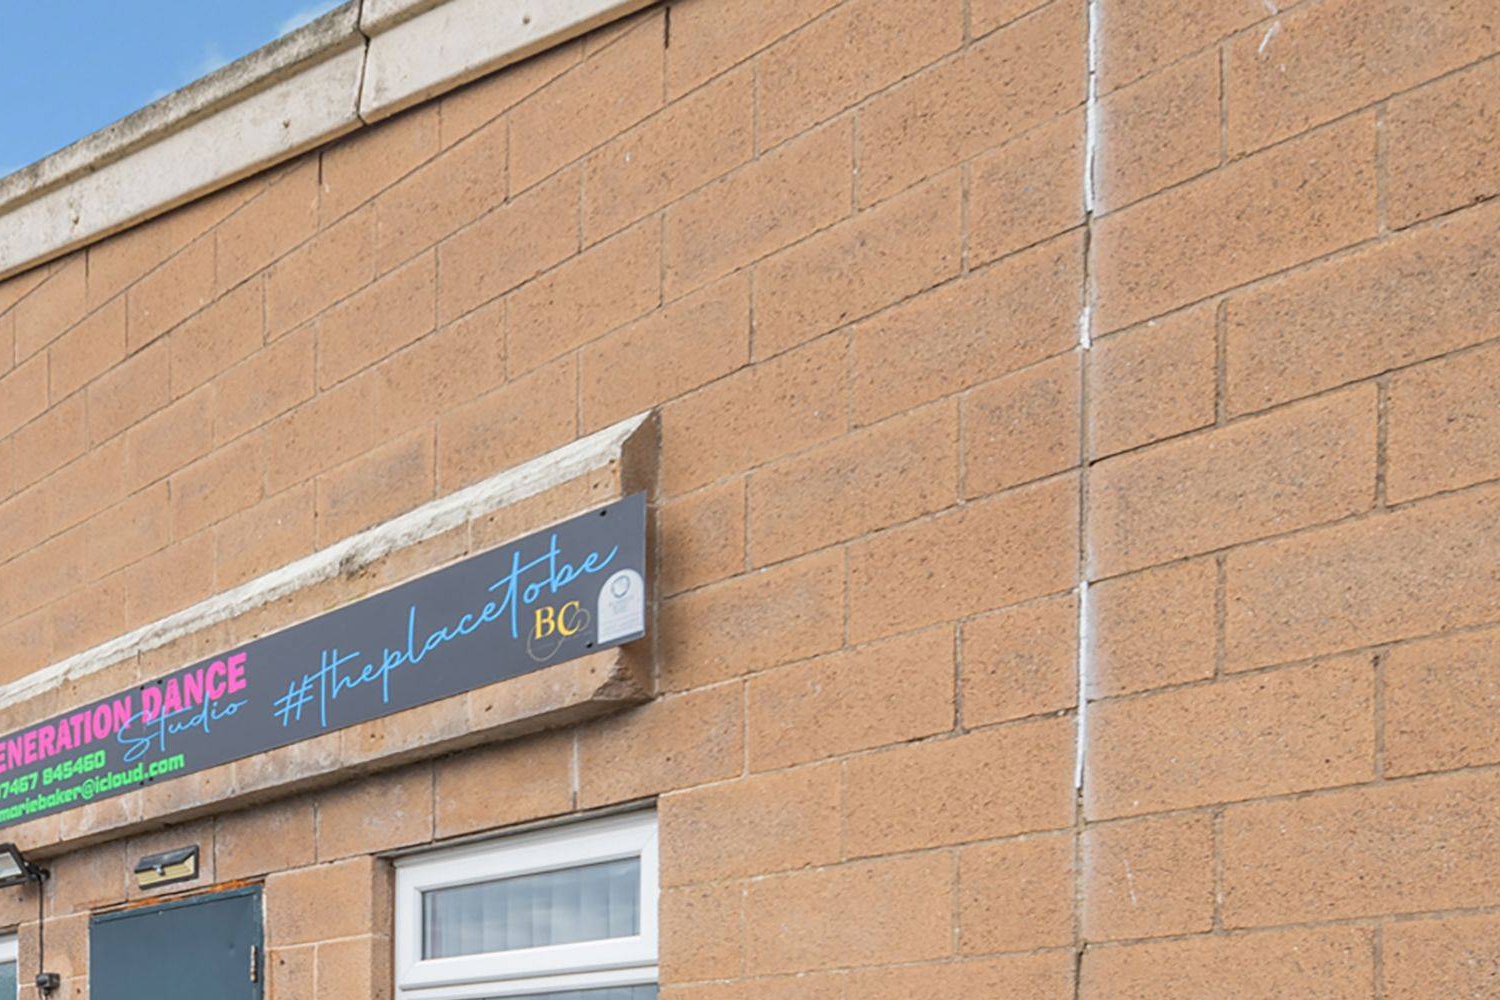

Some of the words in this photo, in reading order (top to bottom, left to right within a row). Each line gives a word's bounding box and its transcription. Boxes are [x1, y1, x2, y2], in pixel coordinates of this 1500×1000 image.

[273, 534, 619, 727] #theplacetobe
[534, 600, 580, 640] BC
[141, 652, 247, 723] DANCE
[117, 690, 248, 762] Studio
[42, 749, 106, 786] 845460
